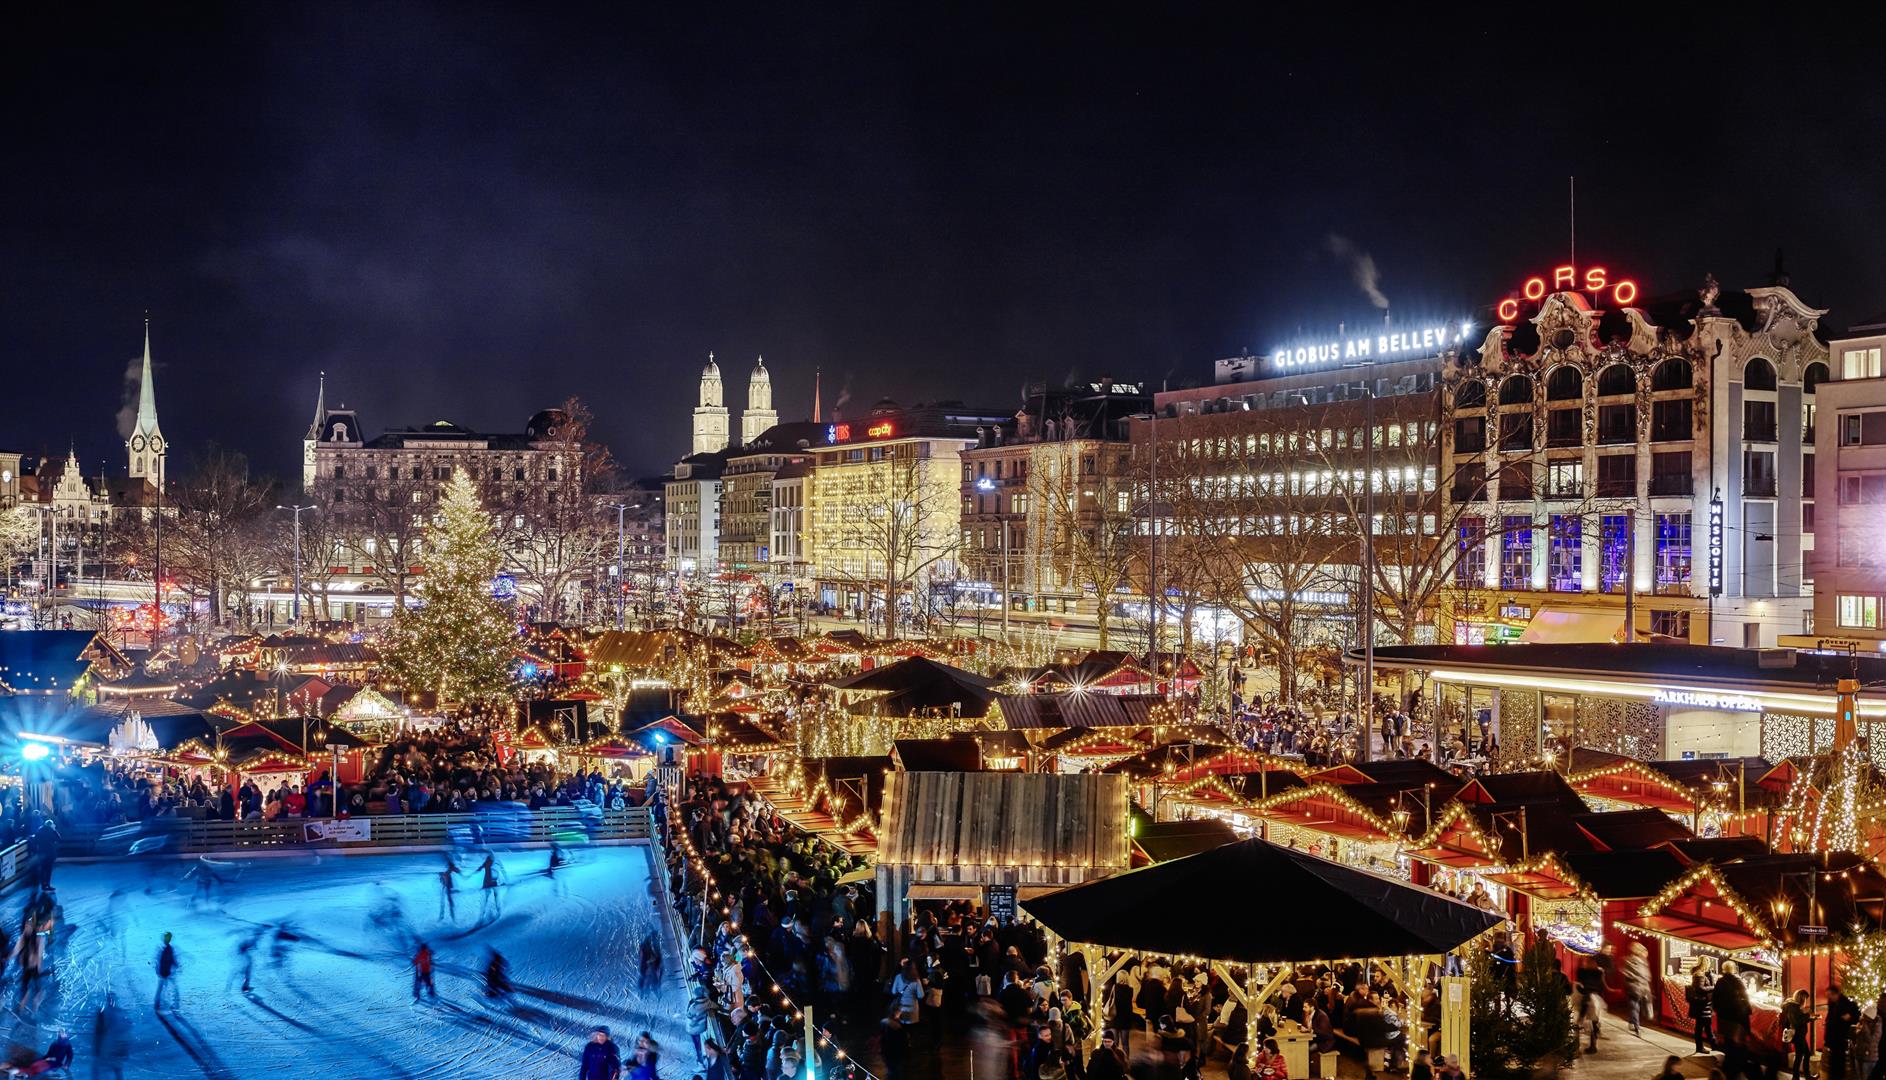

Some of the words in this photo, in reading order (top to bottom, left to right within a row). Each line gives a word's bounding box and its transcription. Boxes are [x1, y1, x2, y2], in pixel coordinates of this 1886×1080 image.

[1499, 267, 1636, 320] CORSO
[1275, 343, 1339, 367] GLOBUS
[1346, 339, 1370, 358] AM
[1378, 324, 1471, 353] BELLEVE
[836, 425, 850, 440] UBS
[868, 427, 881, 437] coop
[881, 424, 892, 436] city
[1711, 505, 1721, 587] MASCOTTE
[1303, 591, 1348, 603] BELLEVUE
[1654, 690, 1718, 708] PARKHAUS
